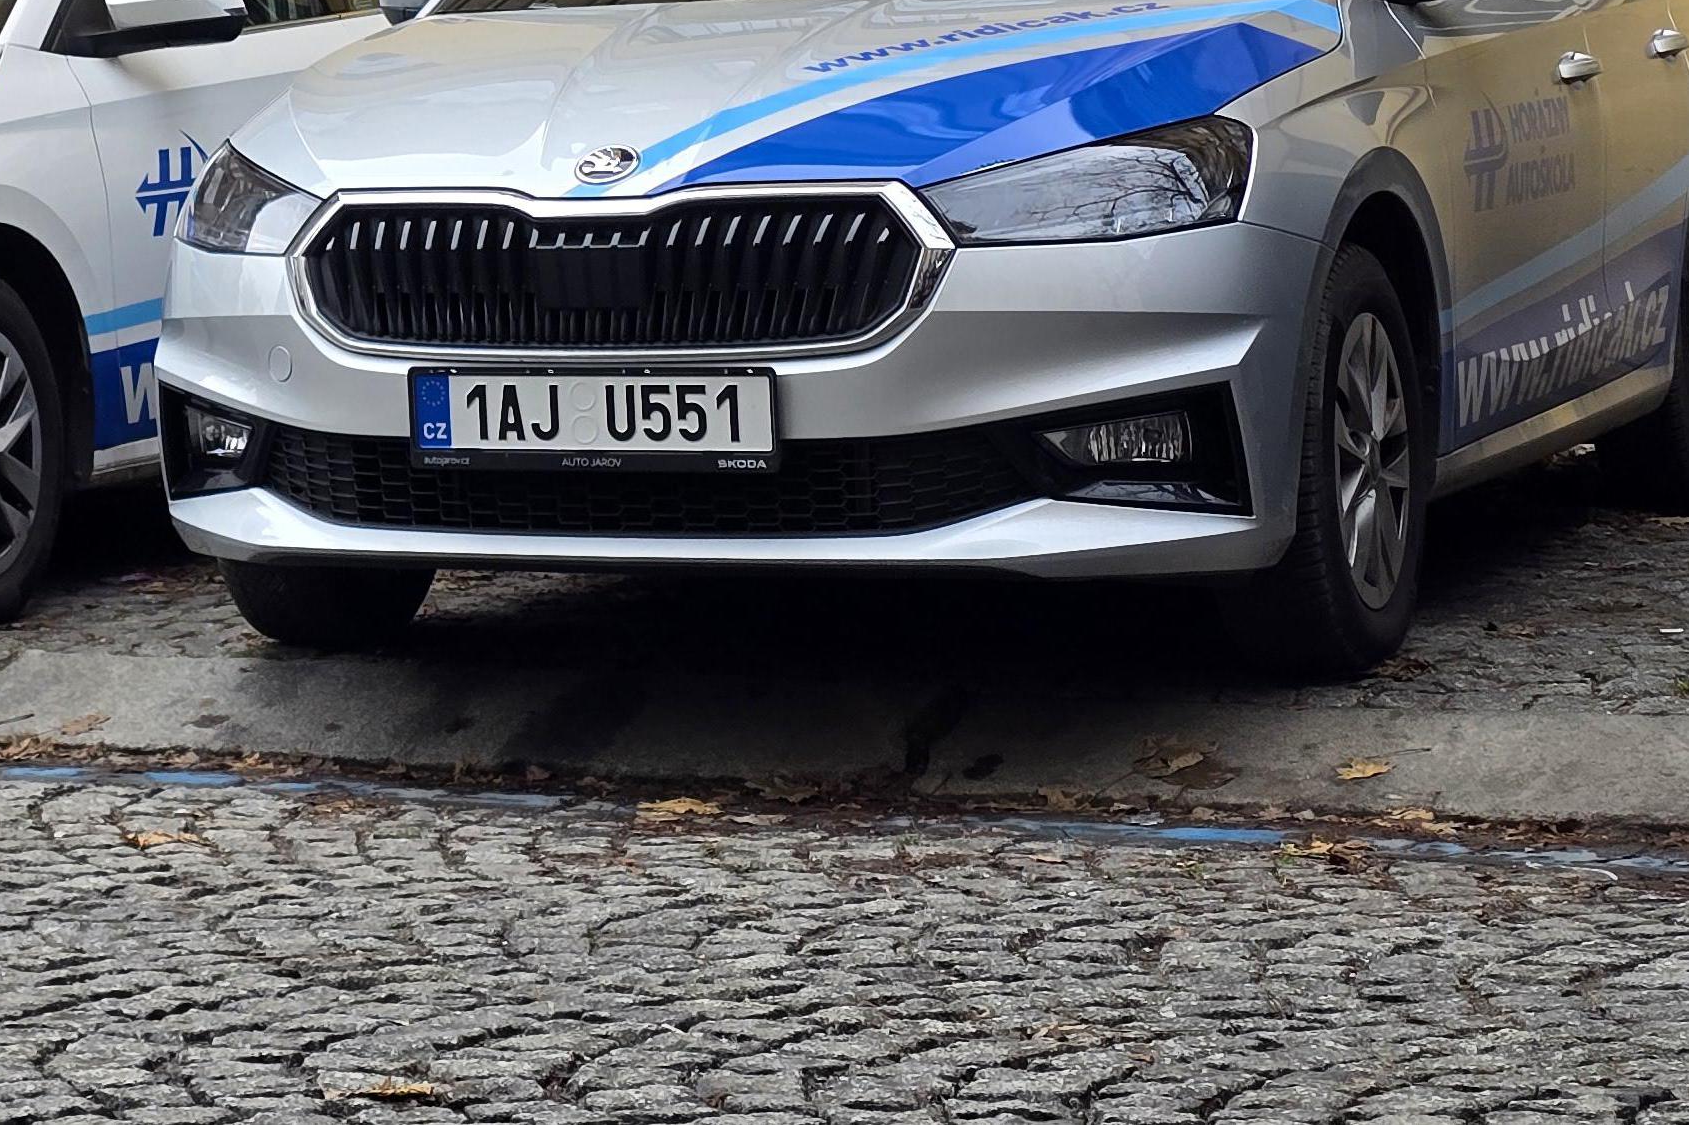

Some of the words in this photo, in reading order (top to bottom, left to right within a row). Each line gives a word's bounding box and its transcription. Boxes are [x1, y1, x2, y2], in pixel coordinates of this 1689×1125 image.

[804, 1, 1171, 75] www.ridicak.cz
[422, 422, 449, 440] CZ
[466, 383, 561, 442] 1AJ
[604, 383, 742, 443] U551
[561, 457, 589, 468] AUTO
[590, 457, 623, 469] JAROV
